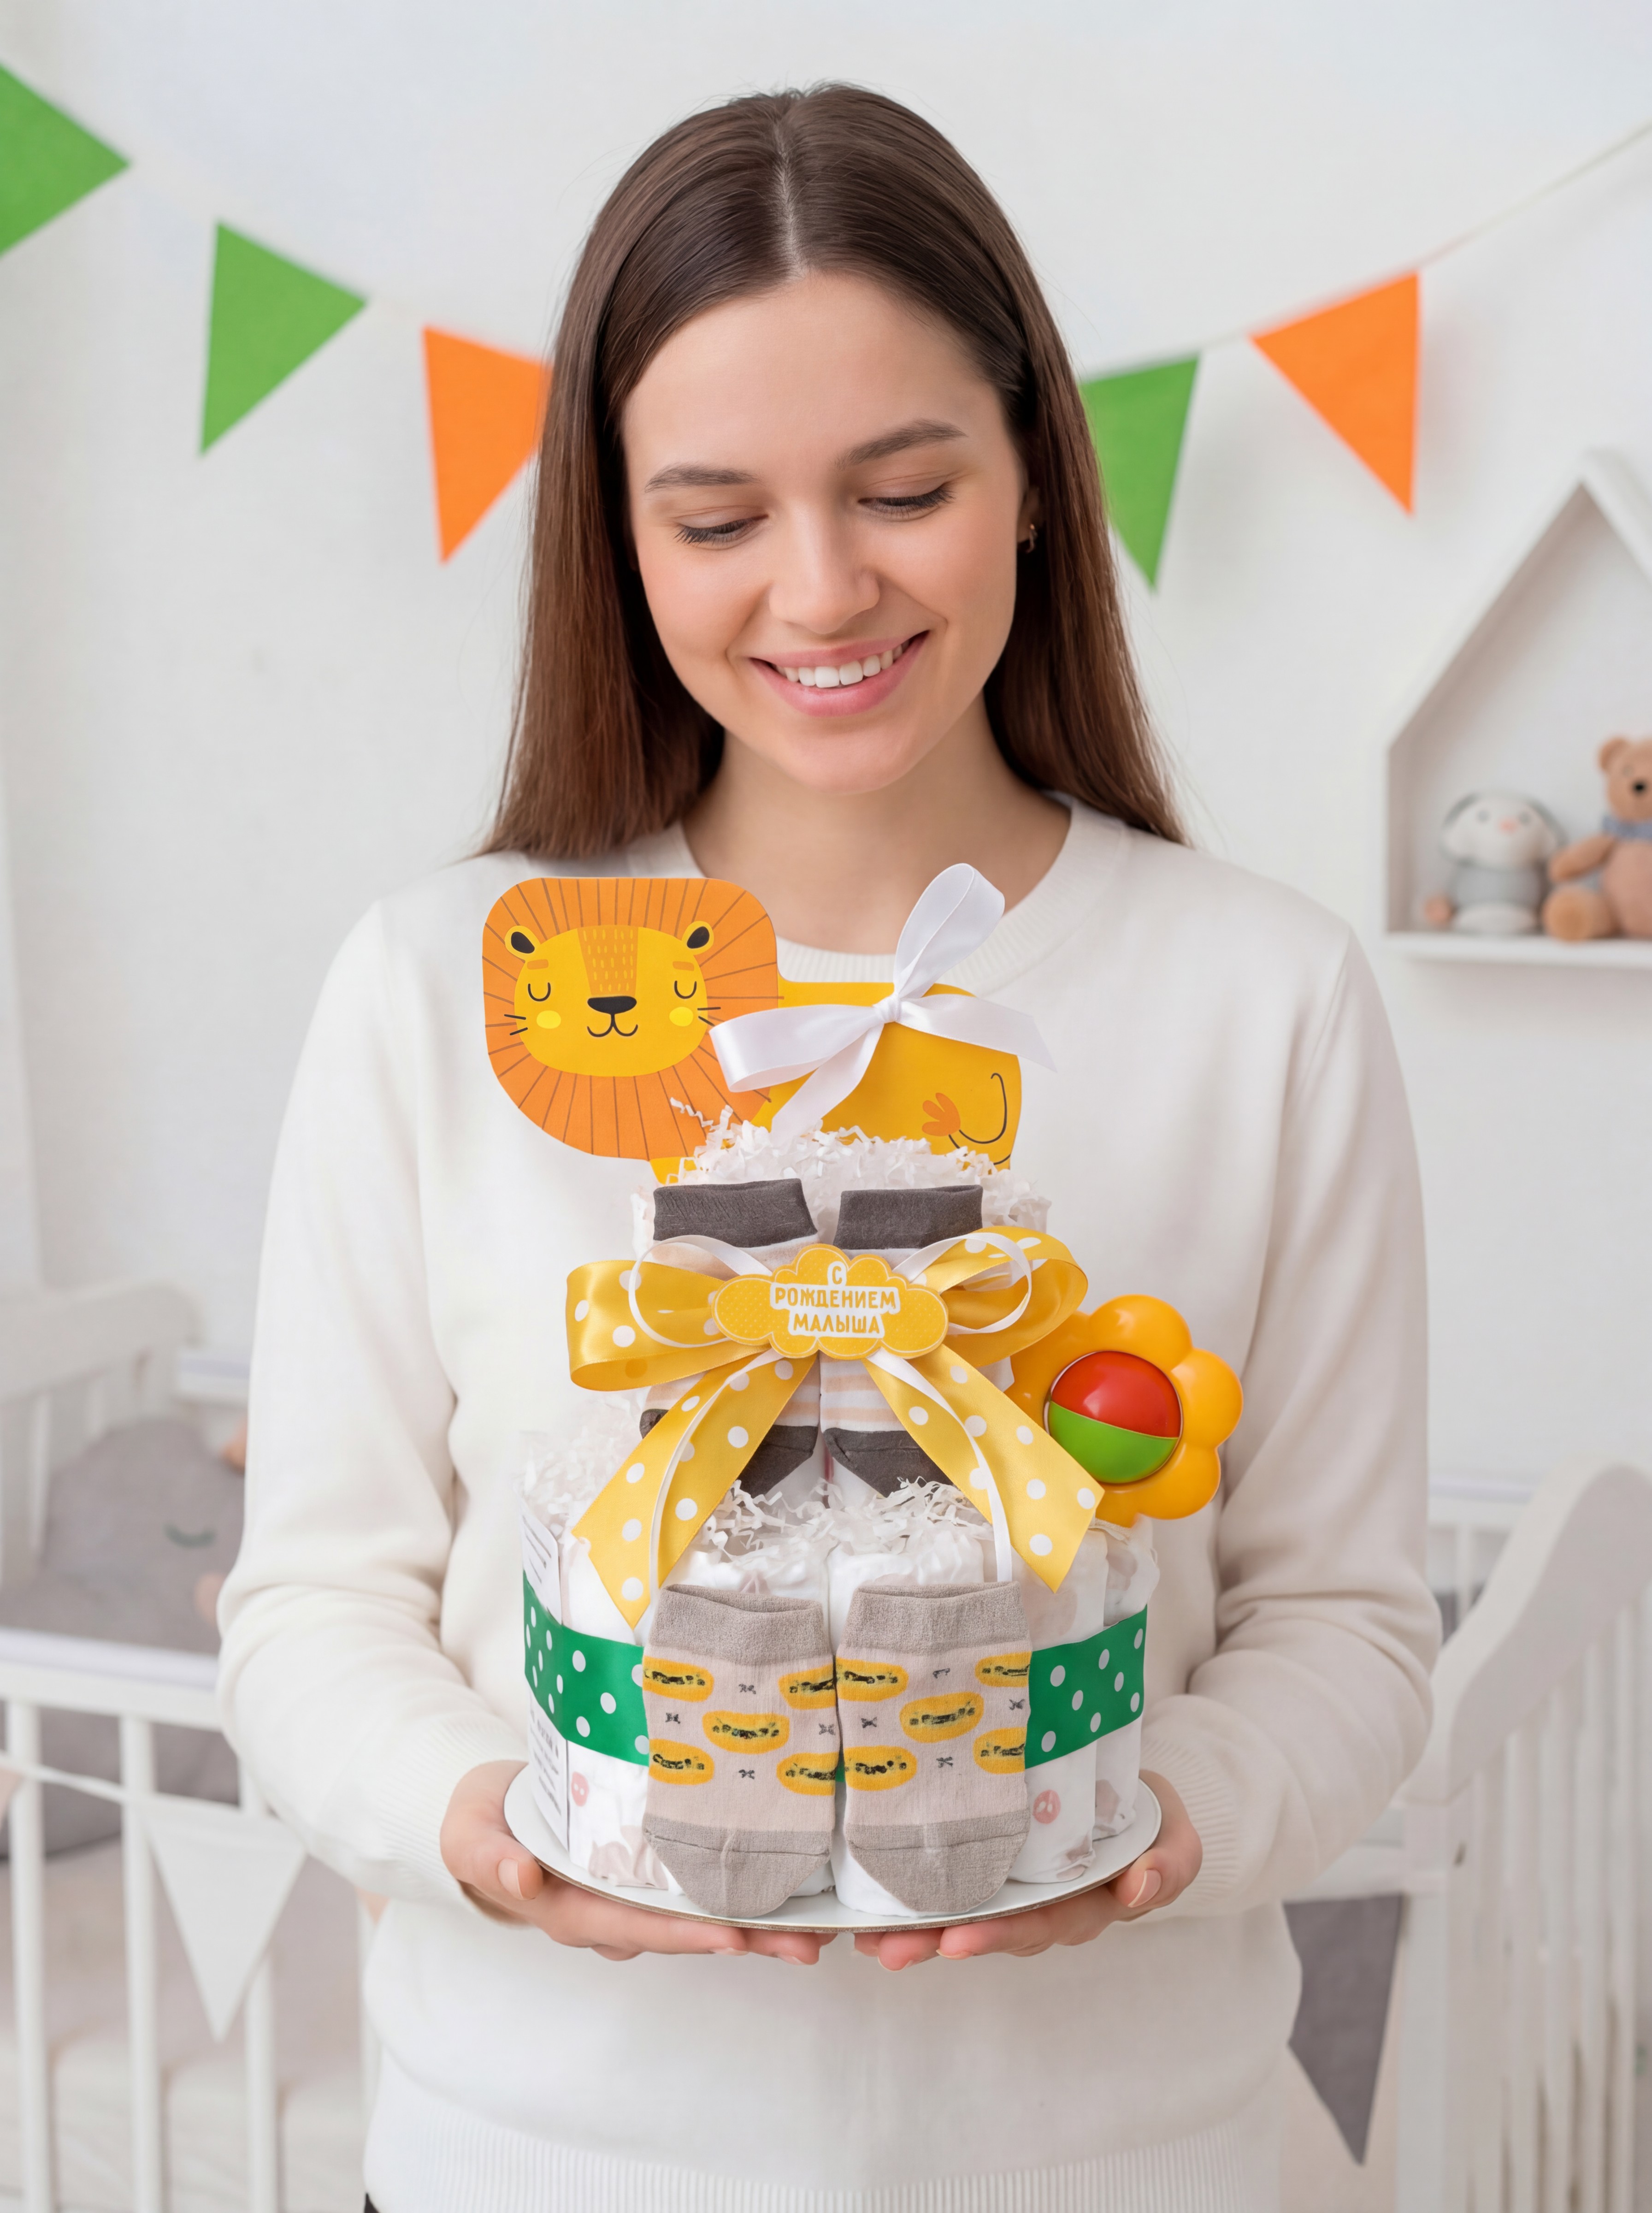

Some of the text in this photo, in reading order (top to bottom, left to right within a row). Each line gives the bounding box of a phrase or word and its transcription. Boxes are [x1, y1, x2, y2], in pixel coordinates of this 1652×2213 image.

[832, 1266, 842, 1284] С
[775, 1288, 896, 1309] РОЖДЕНИЕМ
[793, 1314, 880, 1333] МАЛЫША
